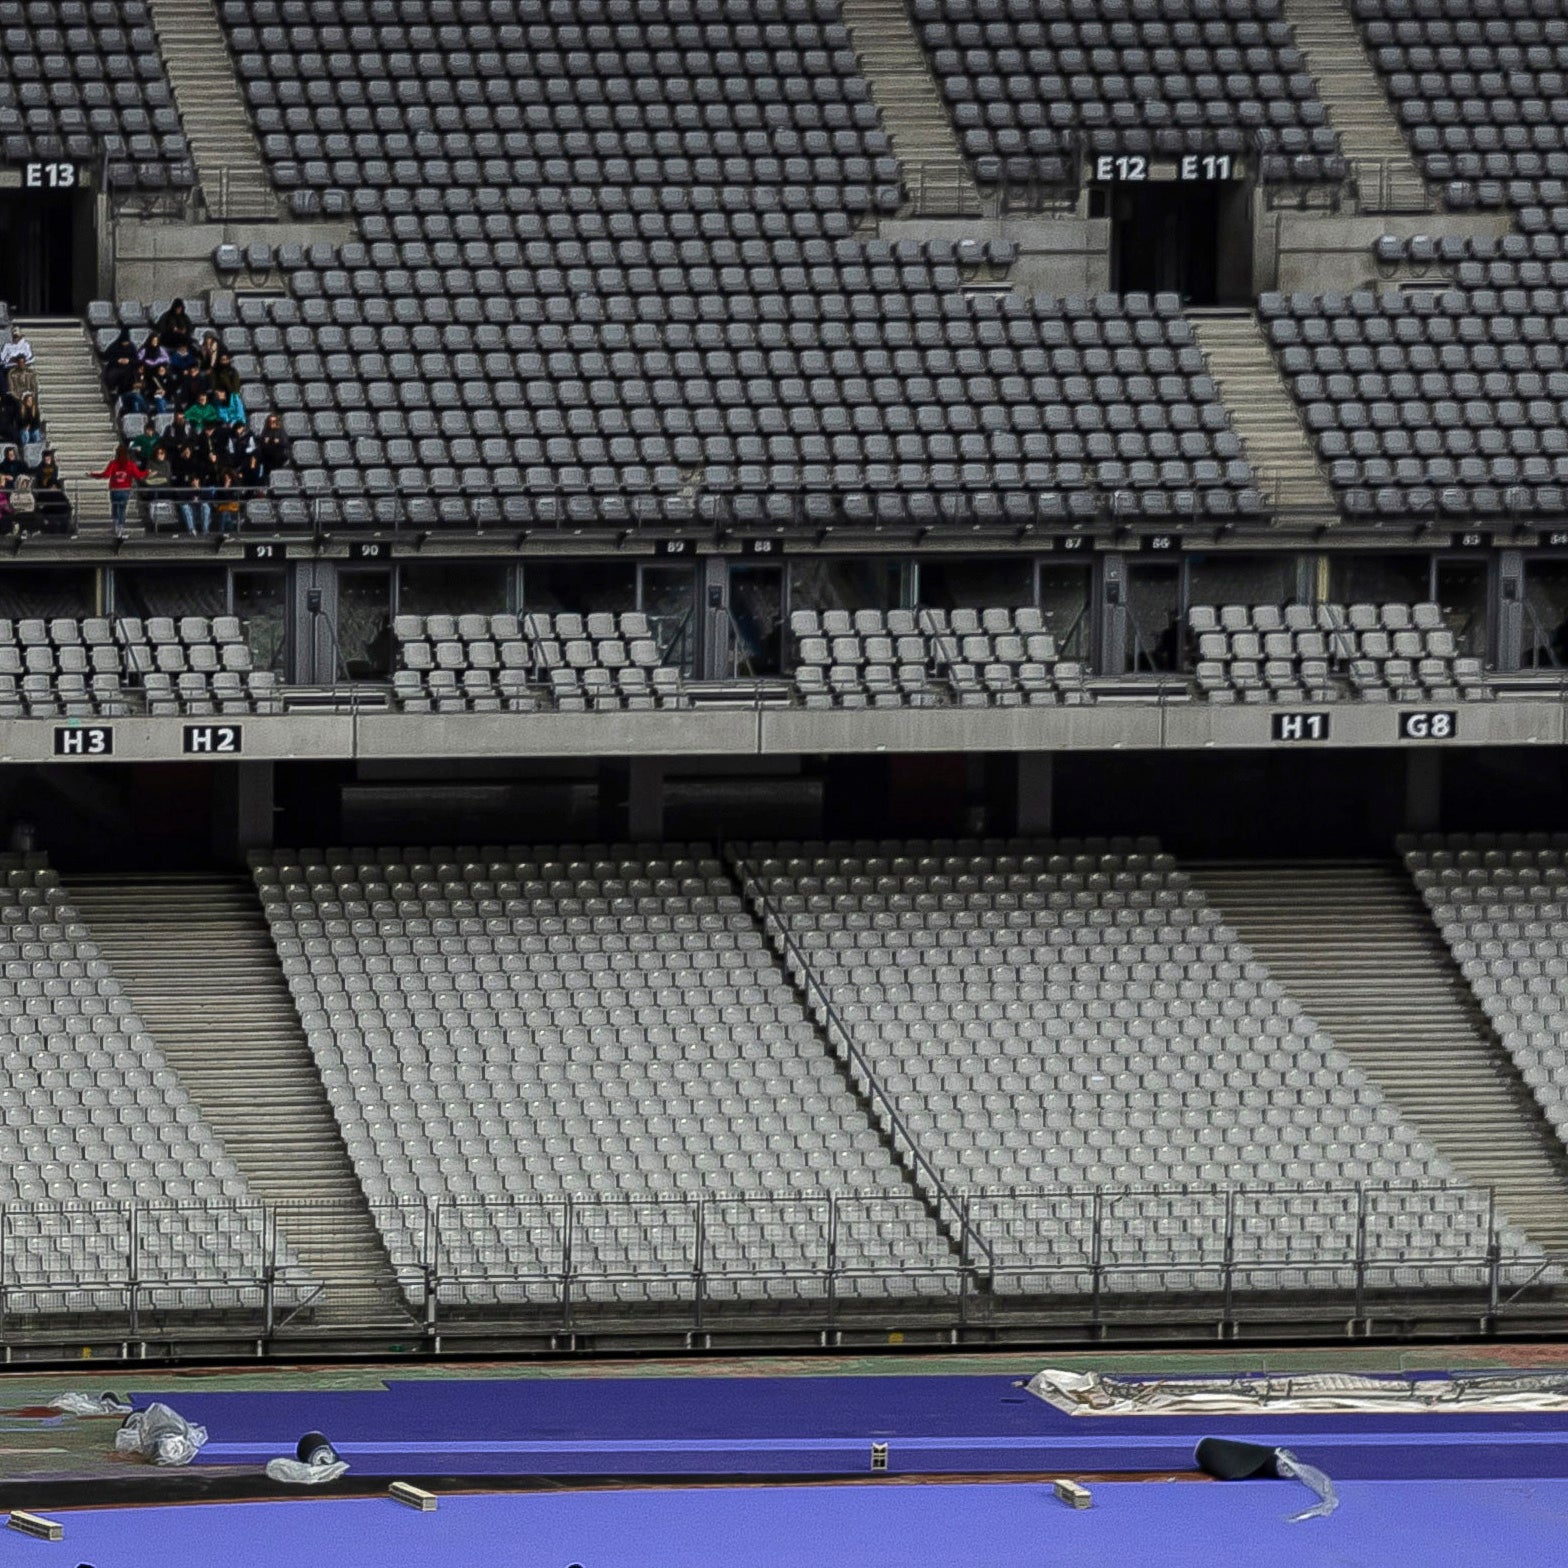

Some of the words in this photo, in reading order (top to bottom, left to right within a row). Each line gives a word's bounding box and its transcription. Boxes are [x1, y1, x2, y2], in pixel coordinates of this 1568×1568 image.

[26, 162, 75, 188] E13
[1096, 155, 1146, 181] E12
[1181, 154, 1230, 180] E11
[256, 545, 273, 557] 91
[361, 544, 379, 557] 90
[1281, 712, 1321, 739] H1
[1406, 712, 1451, 738] G8
[63, 728, 106, 754] H3
[192, 727, 235, 752] H2
